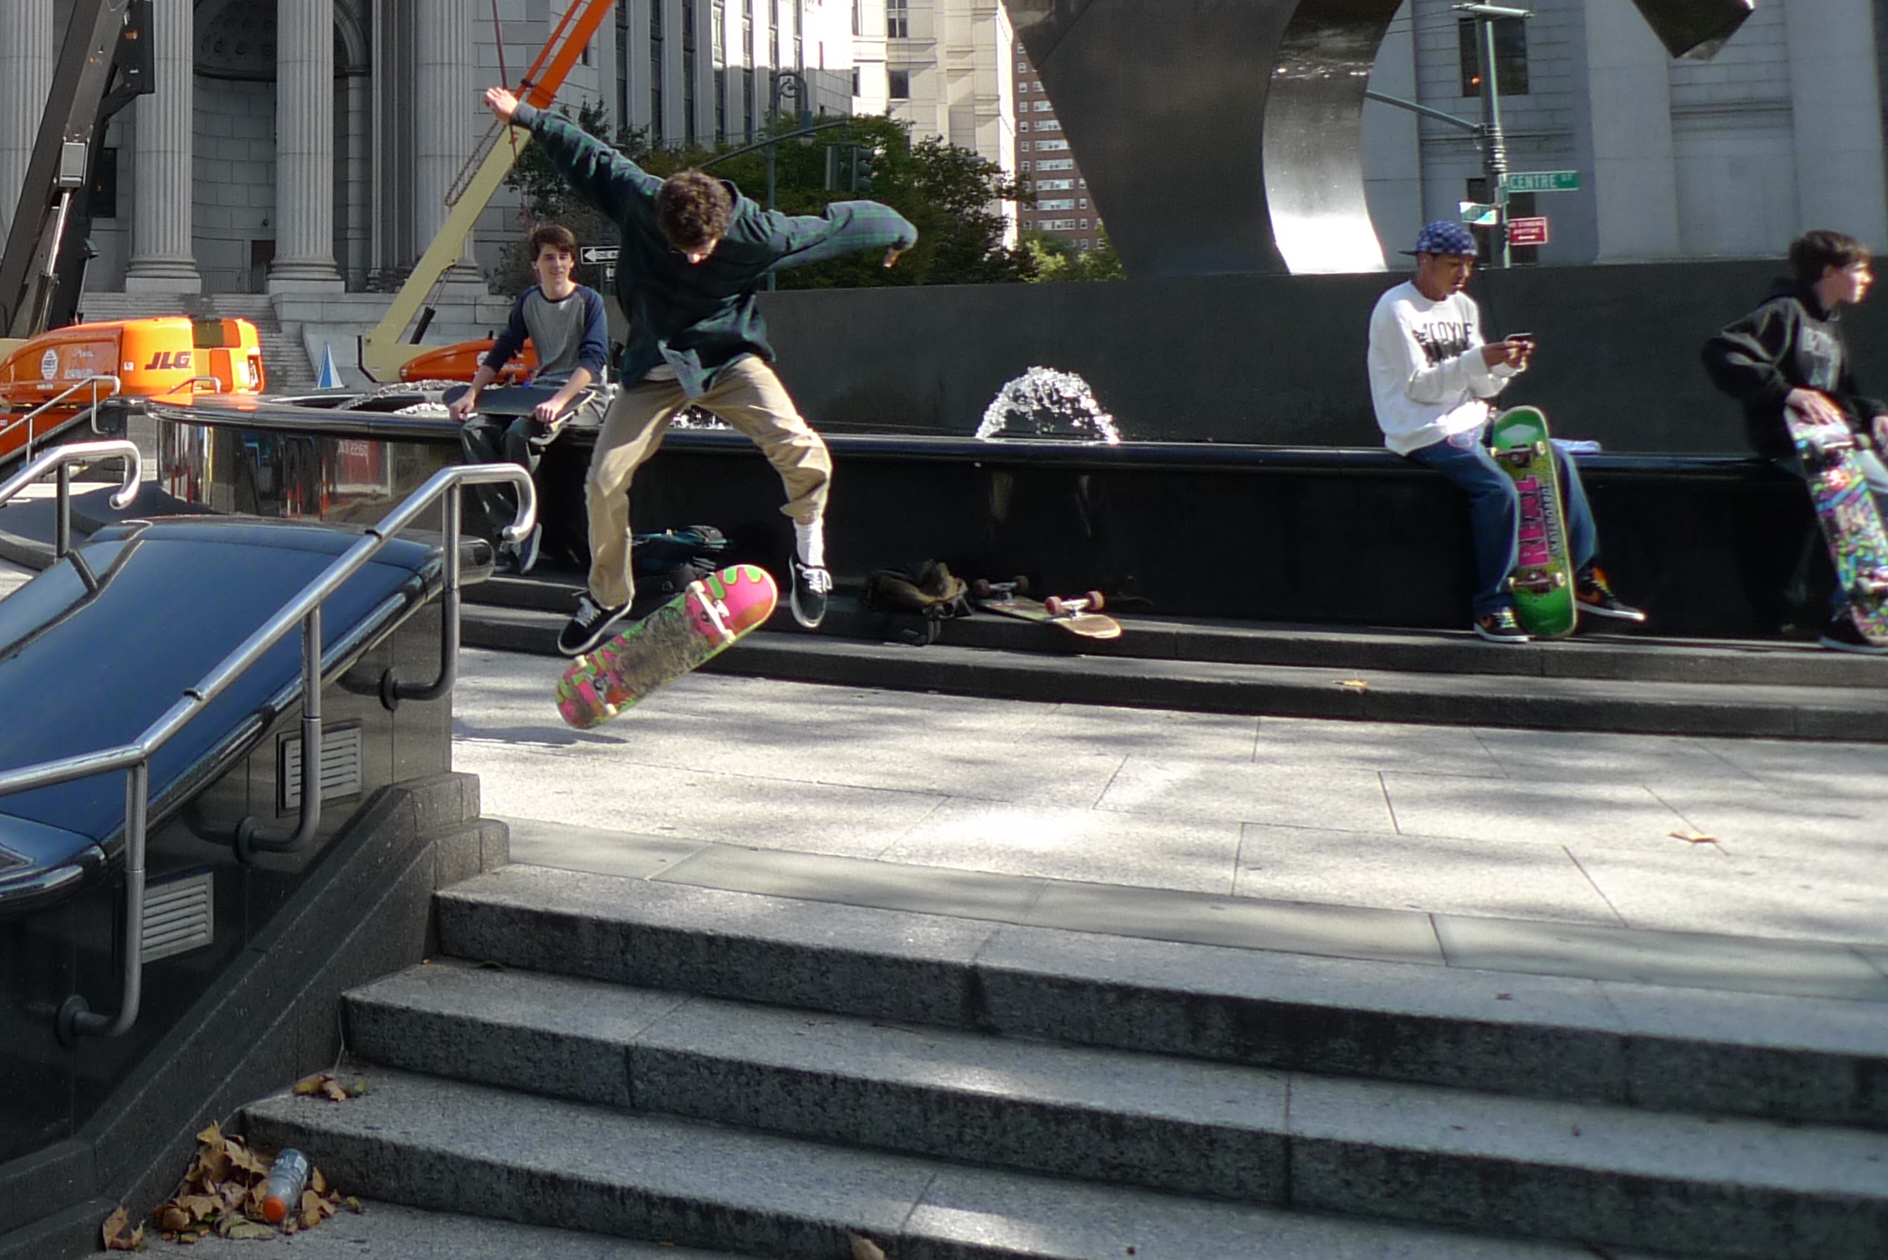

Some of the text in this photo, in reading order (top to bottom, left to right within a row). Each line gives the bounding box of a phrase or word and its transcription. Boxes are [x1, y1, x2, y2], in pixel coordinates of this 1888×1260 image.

[1510, 174, 1557, 189] CENTRE
[143, 351, 192, 371] JLG
[1515, 474, 1550, 568] REAL
